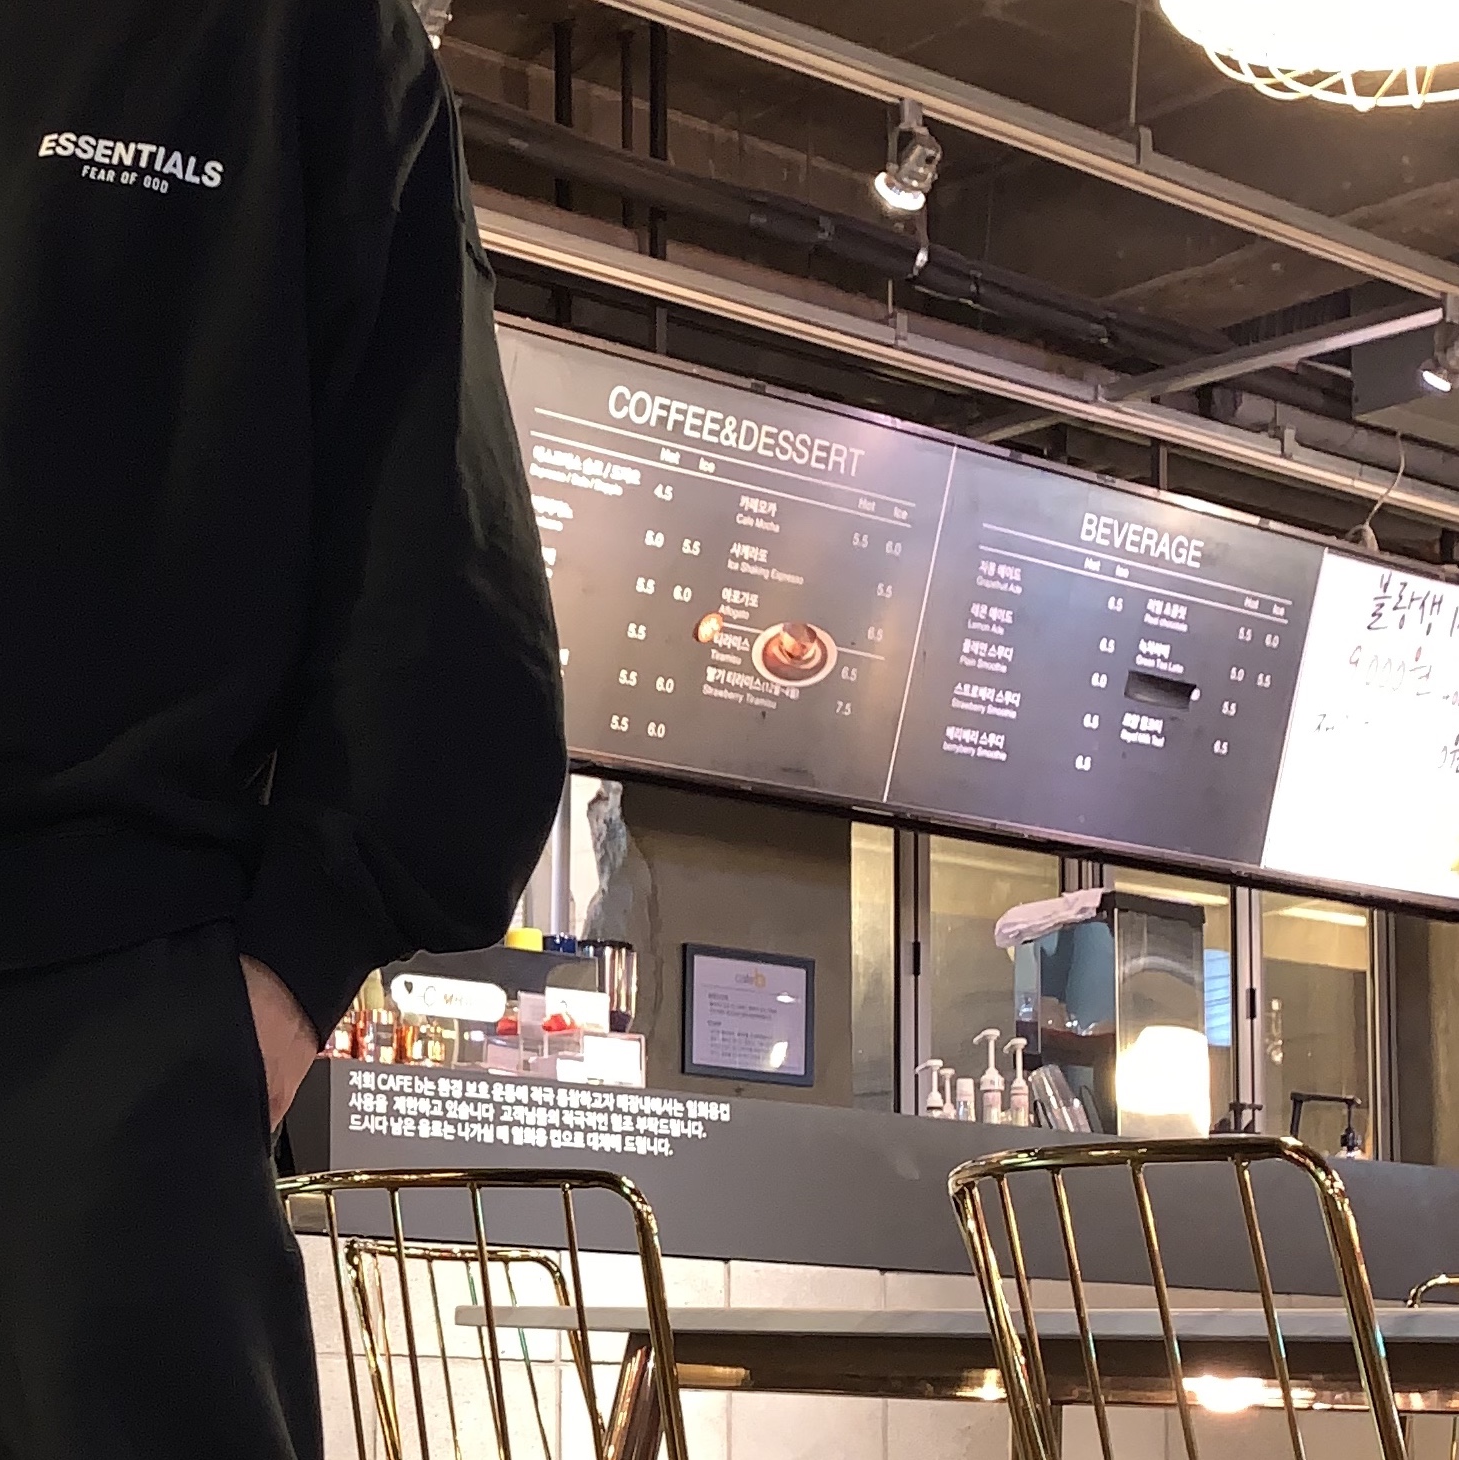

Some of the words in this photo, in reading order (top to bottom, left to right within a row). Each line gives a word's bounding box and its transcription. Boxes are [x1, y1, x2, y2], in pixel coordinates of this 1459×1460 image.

[38, 132, 224, 188] ESSENTIALS
[81, 165, 115, 183] FEAR
[120, 170, 138, 185] OF
[143, 175, 169, 194] GOD
[608, 385, 865, 476] COFFEE&DESSERT
[654, 483, 673, 501] 4.5
[645, 530, 664, 548] 5.0
[682, 538, 700, 555] 5.5
[852, 532, 869, 548] 5.5
[885, 540, 902, 557] 6.0
[1080, 512, 1205, 568] BEVERAGE
[636, 577, 655, 594] 5.5
[673, 585, 692, 602] 6.0
[627, 623, 646, 640] 5.5
[988, 644, 1014, 662] 스무디
[1099, 637, 1115, 653] 6.5
[619, 669, 638, 686] 5.5
[656, 676, 674, 693] 6.0
[836, 700, 852, 716] 7.5
[995, 690, 1021, 707] 스무디
[610, 715, 629, 731] 5.5
[647, 722, 666, 738] 6.0
[979, 732, 1005, 749] 스무디
[349, 1071, 375, 1091] 저희
[377, 1073, 412, 1092] CAFE
[438, 1077, 462, 1098] 환경
[465, 1081, 490, 1099] 보호
[492, 1082, 528, 1104] 운동에
[530, 1086, 555, 1106] 적극
[686, 1100, 730, 1122] 일회용컵
[349, 1092, 388, 1113] 사용을
[393, 1096, 443, 1116] 제한하고
[445, 1100, 495, 1121] 있습니다
[500, 1105, 560, 1127] 고객님들의
[562, 1110, 608, 1131] 적극적인
[636, 1116, 707, 1139] 부탁드립니다.
[349, 1114, 388, 1135] 드시다
[390, 1116, 416, 1136] 남은
[418, 1118, 456, 1140] 음료는
[457, 1122, 494, 1143] 나가실
[512, 1125, 548, 1147] 일회용
[549, 1129, 585, 1148] 컵으로
[624, 1135, 674, 1156] 드립니다.
